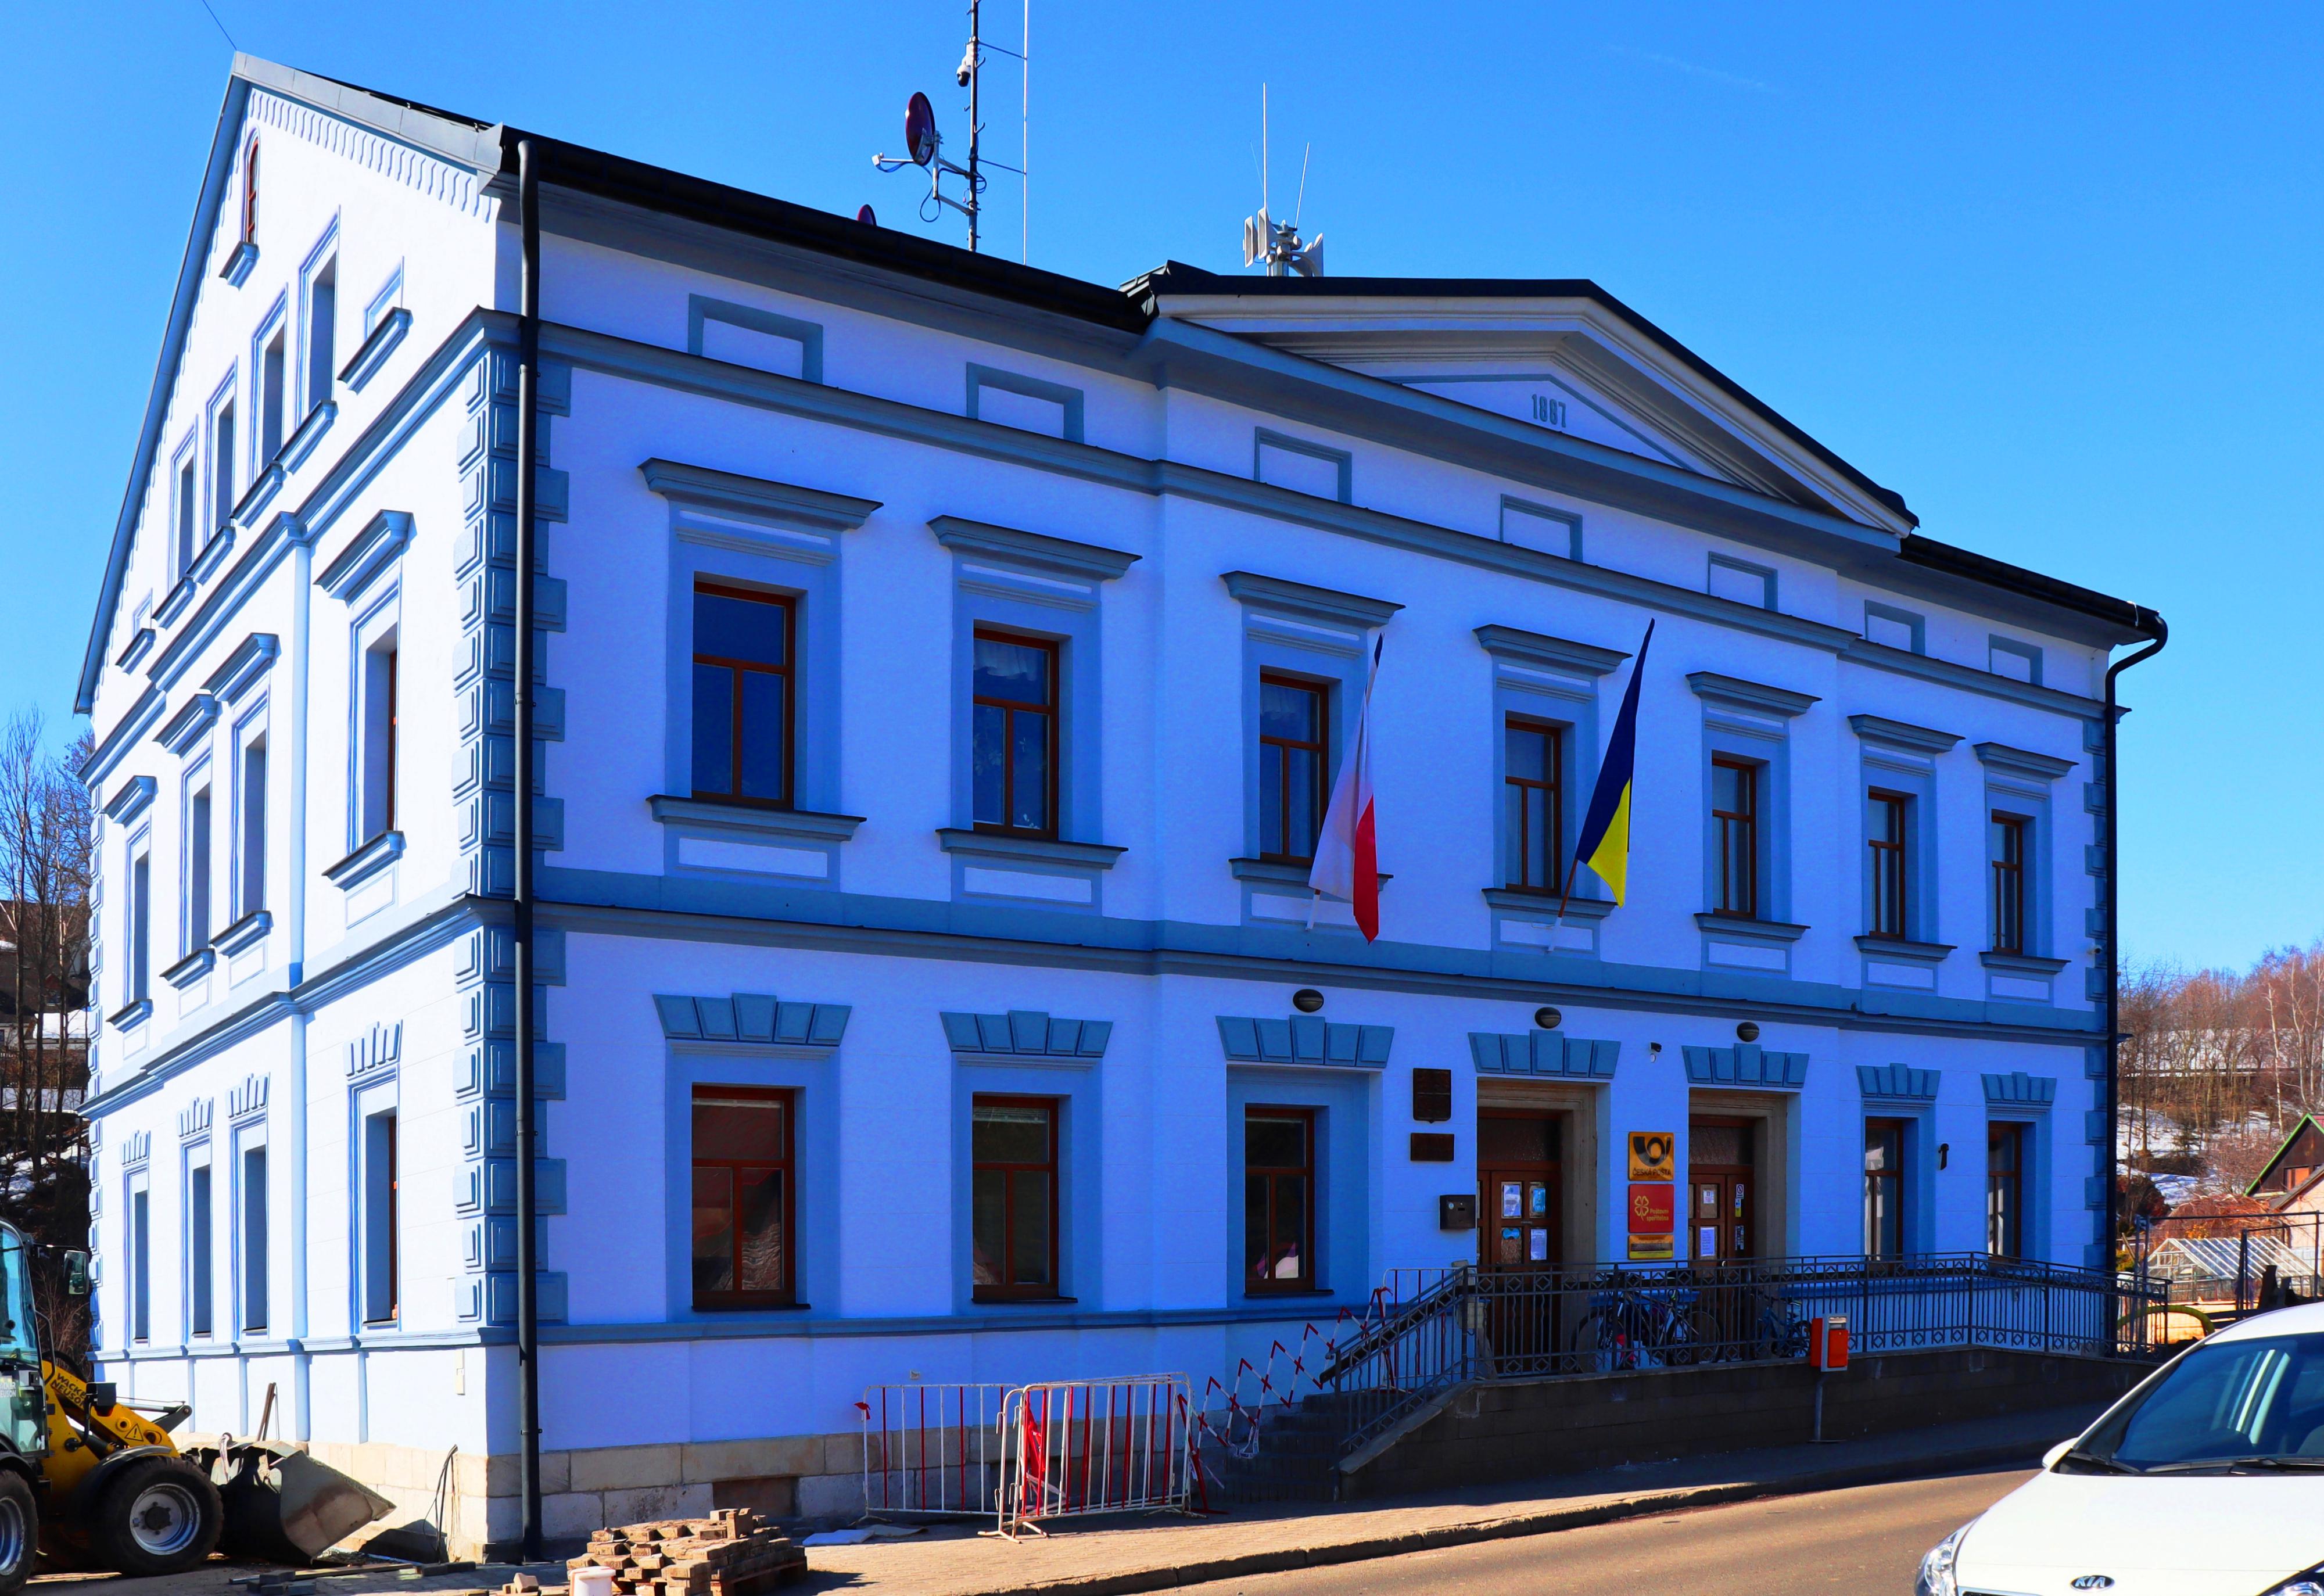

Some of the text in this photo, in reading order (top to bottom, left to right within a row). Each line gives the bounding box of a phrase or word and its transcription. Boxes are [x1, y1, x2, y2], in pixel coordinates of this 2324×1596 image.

[1532, 393, 1566, 428] 1887
[57, 1373, 87, 1398] WACKE
[2075, 1576, 2106, 1587] KIA
